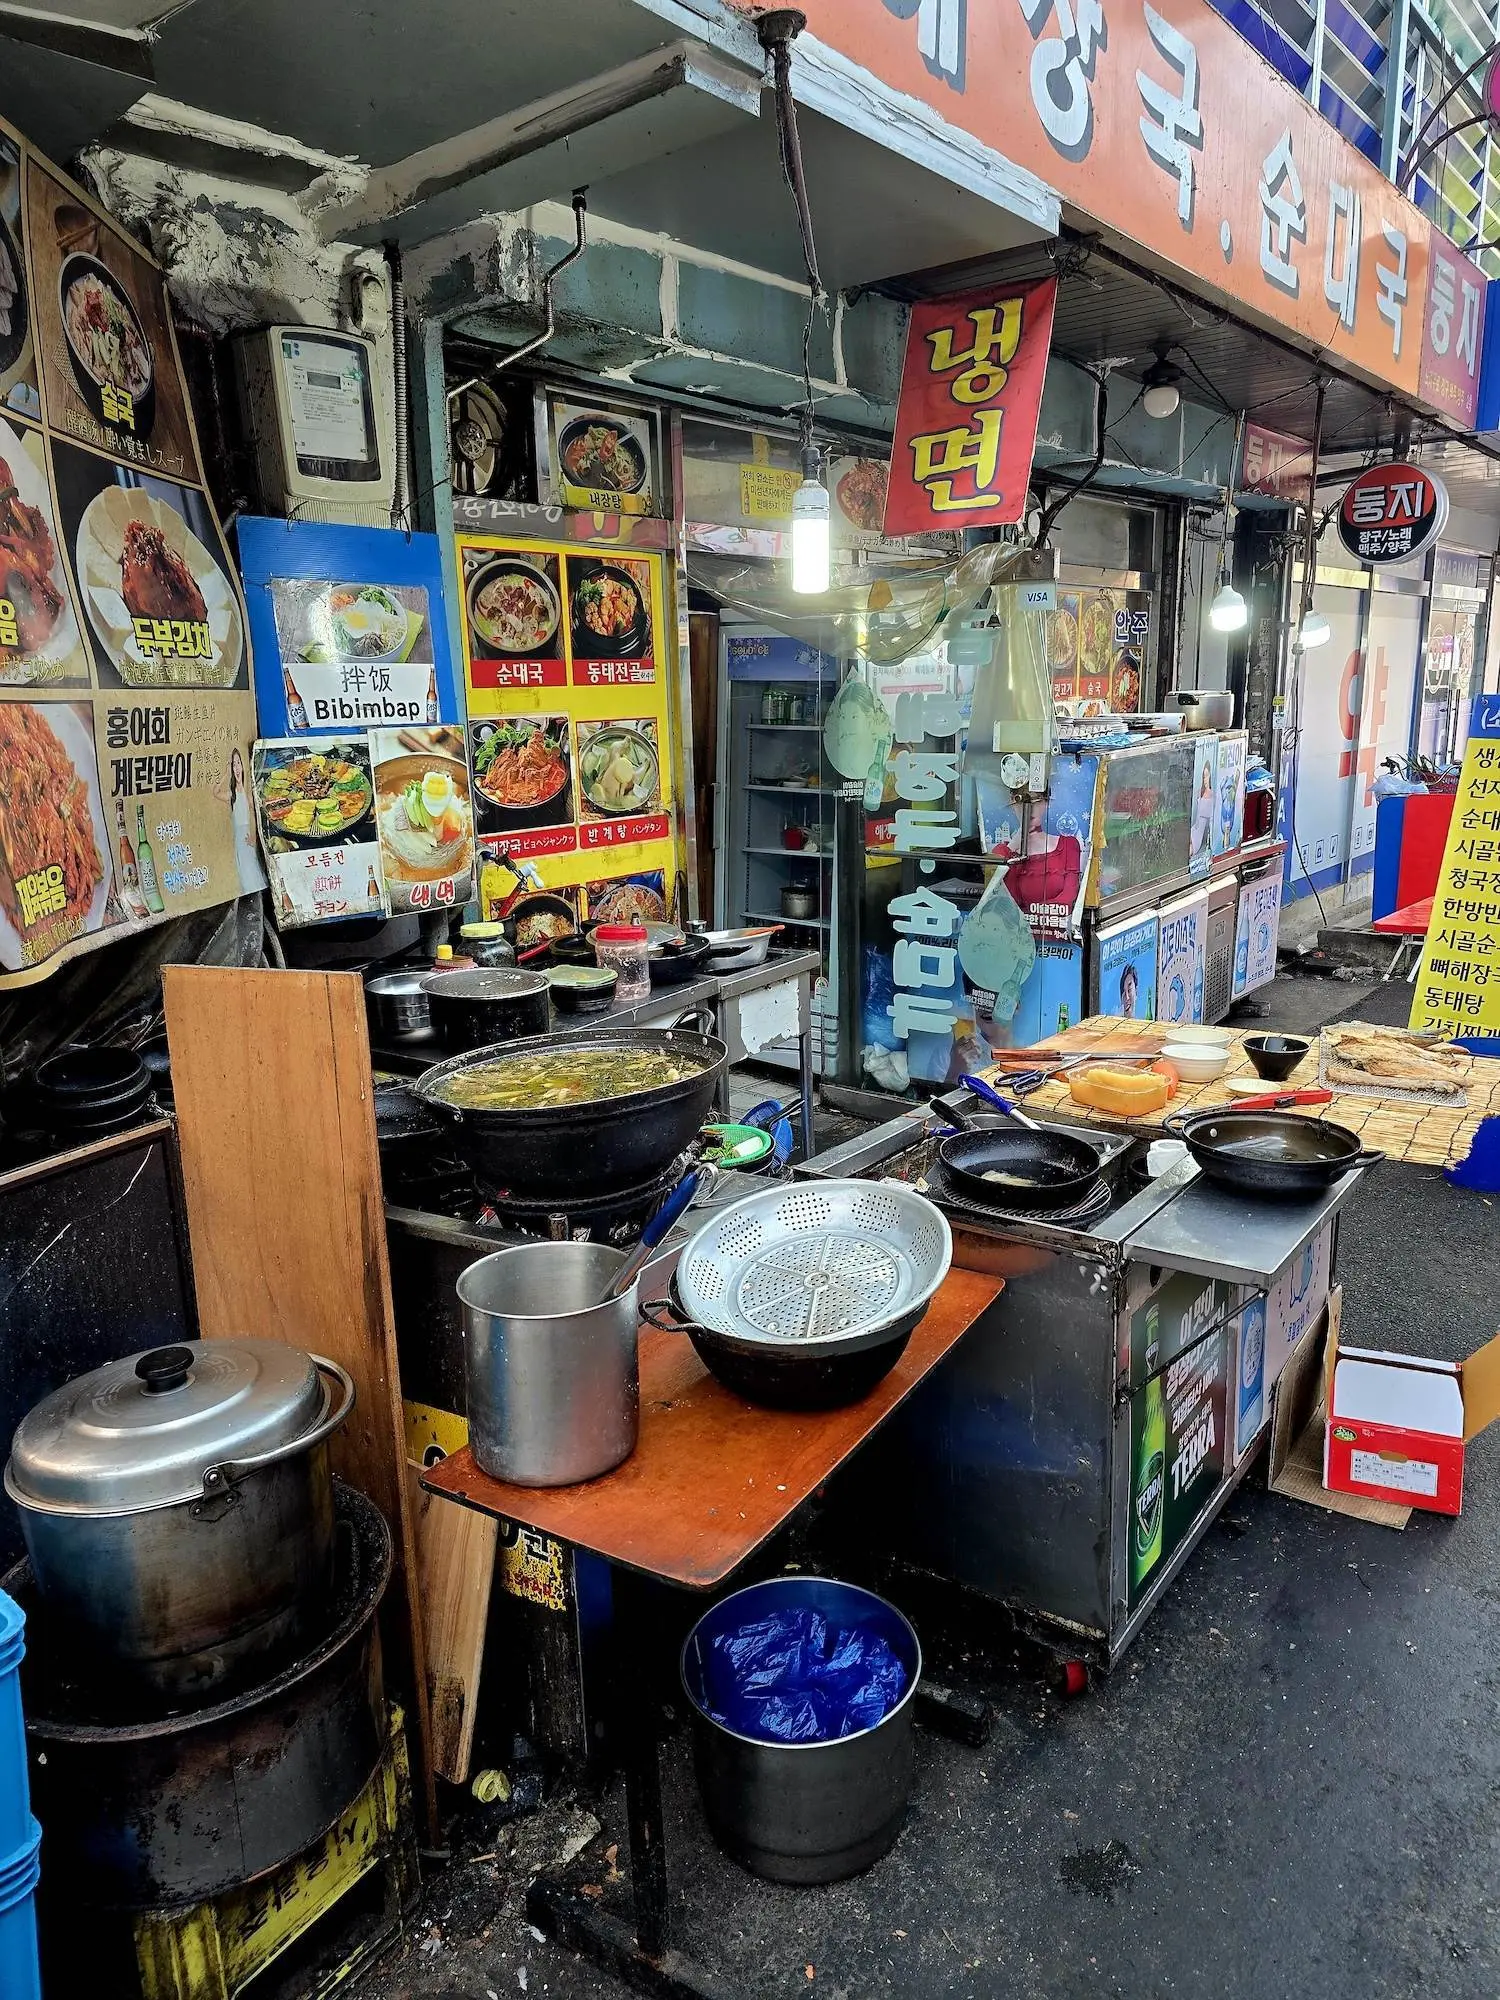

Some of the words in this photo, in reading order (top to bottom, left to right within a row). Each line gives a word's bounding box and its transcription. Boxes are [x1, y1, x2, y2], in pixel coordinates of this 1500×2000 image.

[1259, 127, 1408, 356] 순대국
[1431, 252, 1481, 378] 둥지
[101, 380, 135, 430] 술국
[911, 298, 1024, 511] 냉면
[1353, 482, 1425, 524] 둥지
[1358, 540, 1412, 556] 맥주/양주
[1359, 526, 1412, 543] 장구/노래
[1027, 592, 1049, 602] VISA
[131, 617, 212, 659] 두부김치
[1114, 608, 1148, 645] 안주
[341, 665, 393, 694] 拌饭
[496, 662, 545, 685] 순대국
[588, 662, 642, 684] 동태전골
[314, 696, 420, 721] Bibimbap
[107, 706, 171, 750] 홍어회
[1474, 747, 1500, 769] 생
[111, 753, 193, 798] 계란말이
[304, 850, 345, 869] 모듬전
[1454, 839, 1500, 862] 시골
[15, 865, 67, 928] 제육볶음
[410, 878, 455, 907] 냉면
[314, 899, 348, 916] チョン
[1030, 902, 1069, 916] 이슬같이
[1035, 945, 1075, 961] 정맥아
[1435, 929, 1500, 955] 시골순
[1424, 986, 1485, 1015] 동태탕
[1171, 1411, 1216, 1501] TERRA
[1137, 1470, 1162, 1511] TERRA
